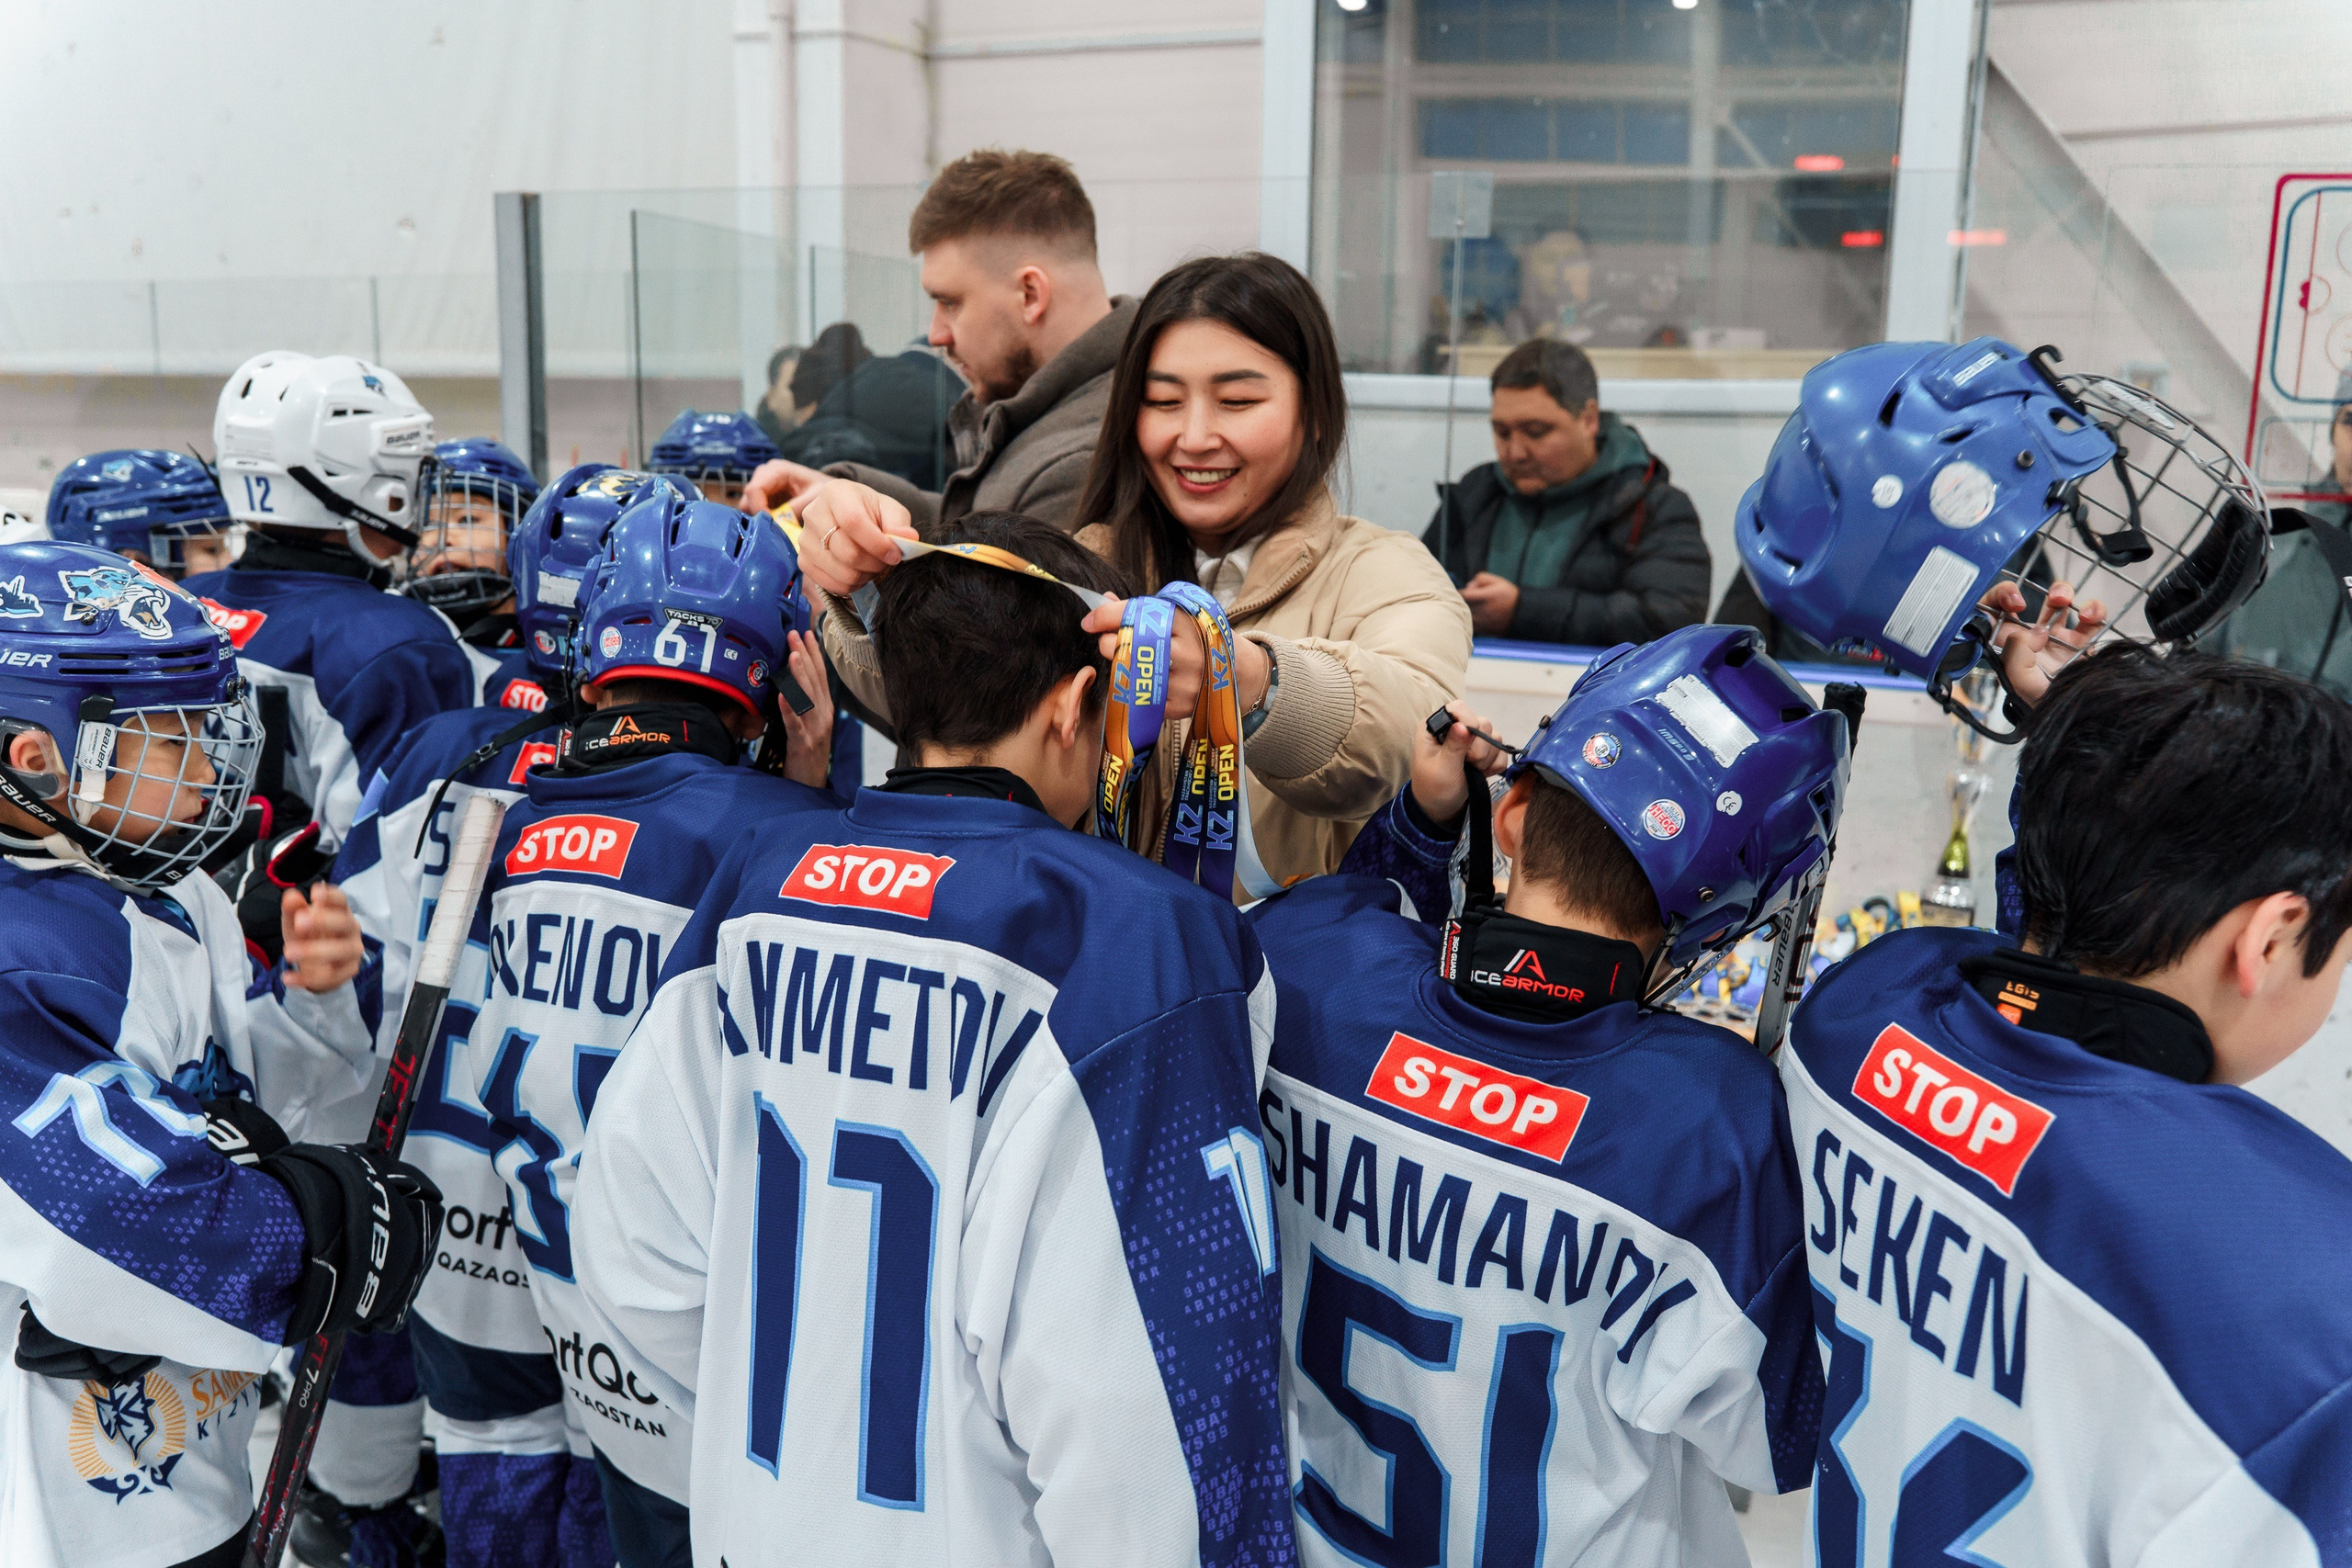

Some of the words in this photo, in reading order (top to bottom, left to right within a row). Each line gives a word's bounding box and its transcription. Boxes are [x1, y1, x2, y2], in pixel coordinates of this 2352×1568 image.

[244, 475, 274, 513] 12
[668, 610, 705, 623] TACKS
[1138, 596, 1171, 638] KZ
[1135, 646, 1155, 706] OPEN
[1210, 643, 1230, 692] KZ
[95, 727, 112, 769] BAUER
[1217, 743, 1234, 801] OPEN
[1103, 754, 1124, 814] OPEN
[516, 822, 618, 863] STOP
[1173, 802, 1203, 846] KZ
[1205, 809, 1234, 851] KZ
[804, 847, 932, 900] STOP
[1771, 914, 1792, 987] BAUER
[1393, 1055, 1559, 1136] STOP
[1872, 1047, 2018, 1155] STOP
[1809, 1128, 2029, 1409] SEKEN
